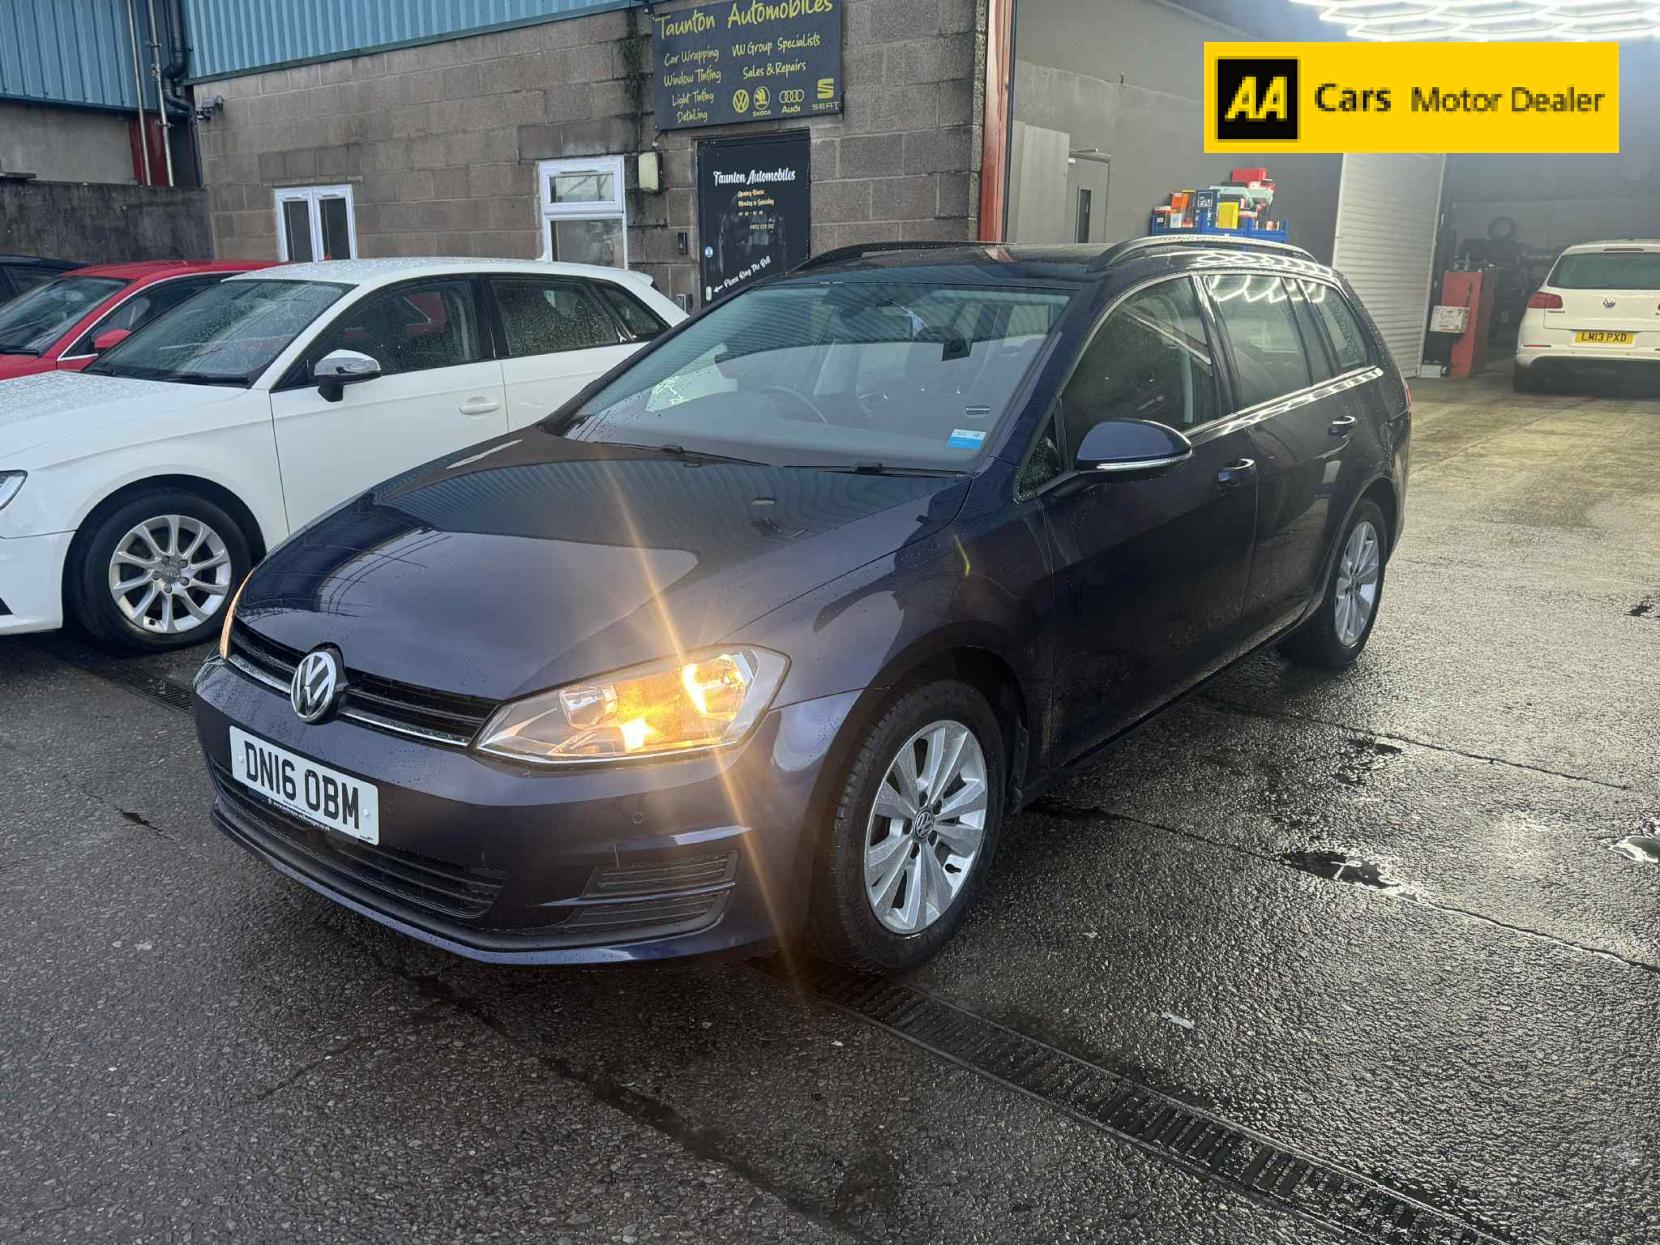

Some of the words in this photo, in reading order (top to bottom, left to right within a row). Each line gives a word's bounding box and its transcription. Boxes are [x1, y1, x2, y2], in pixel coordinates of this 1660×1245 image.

[655, 9, 715, 39] Taunton
[728, 0, 833, 28] Automobiles
[747, 41, 773, 56] Group
[777, 32, 821, 54] Specialists
[664, 53, 680, 66] Car
[681, 45, 720, 65] Wrapping
[664, 71, 694, 87] Window
[695, 65, 721, 84] Tinting
[743, 66, 765, 79] Sales
[766, 63, 776, 76] &
[776, 60, 807, 78] Repairs
[781, 105, 801, 113] Audi
[812, 101, 841, 111] SEAT
[677, 109, 708, 124] Detailing
[713, 171, 746, 187] Taunton
[746, 168, 796, 185] Automobiles
[1581, 332, 1604, 342] LM13
[1606, 332, 1627, 343] PXD
[244, 740, 297, 802] DN16
[304, 768, 360, 831] OBM
